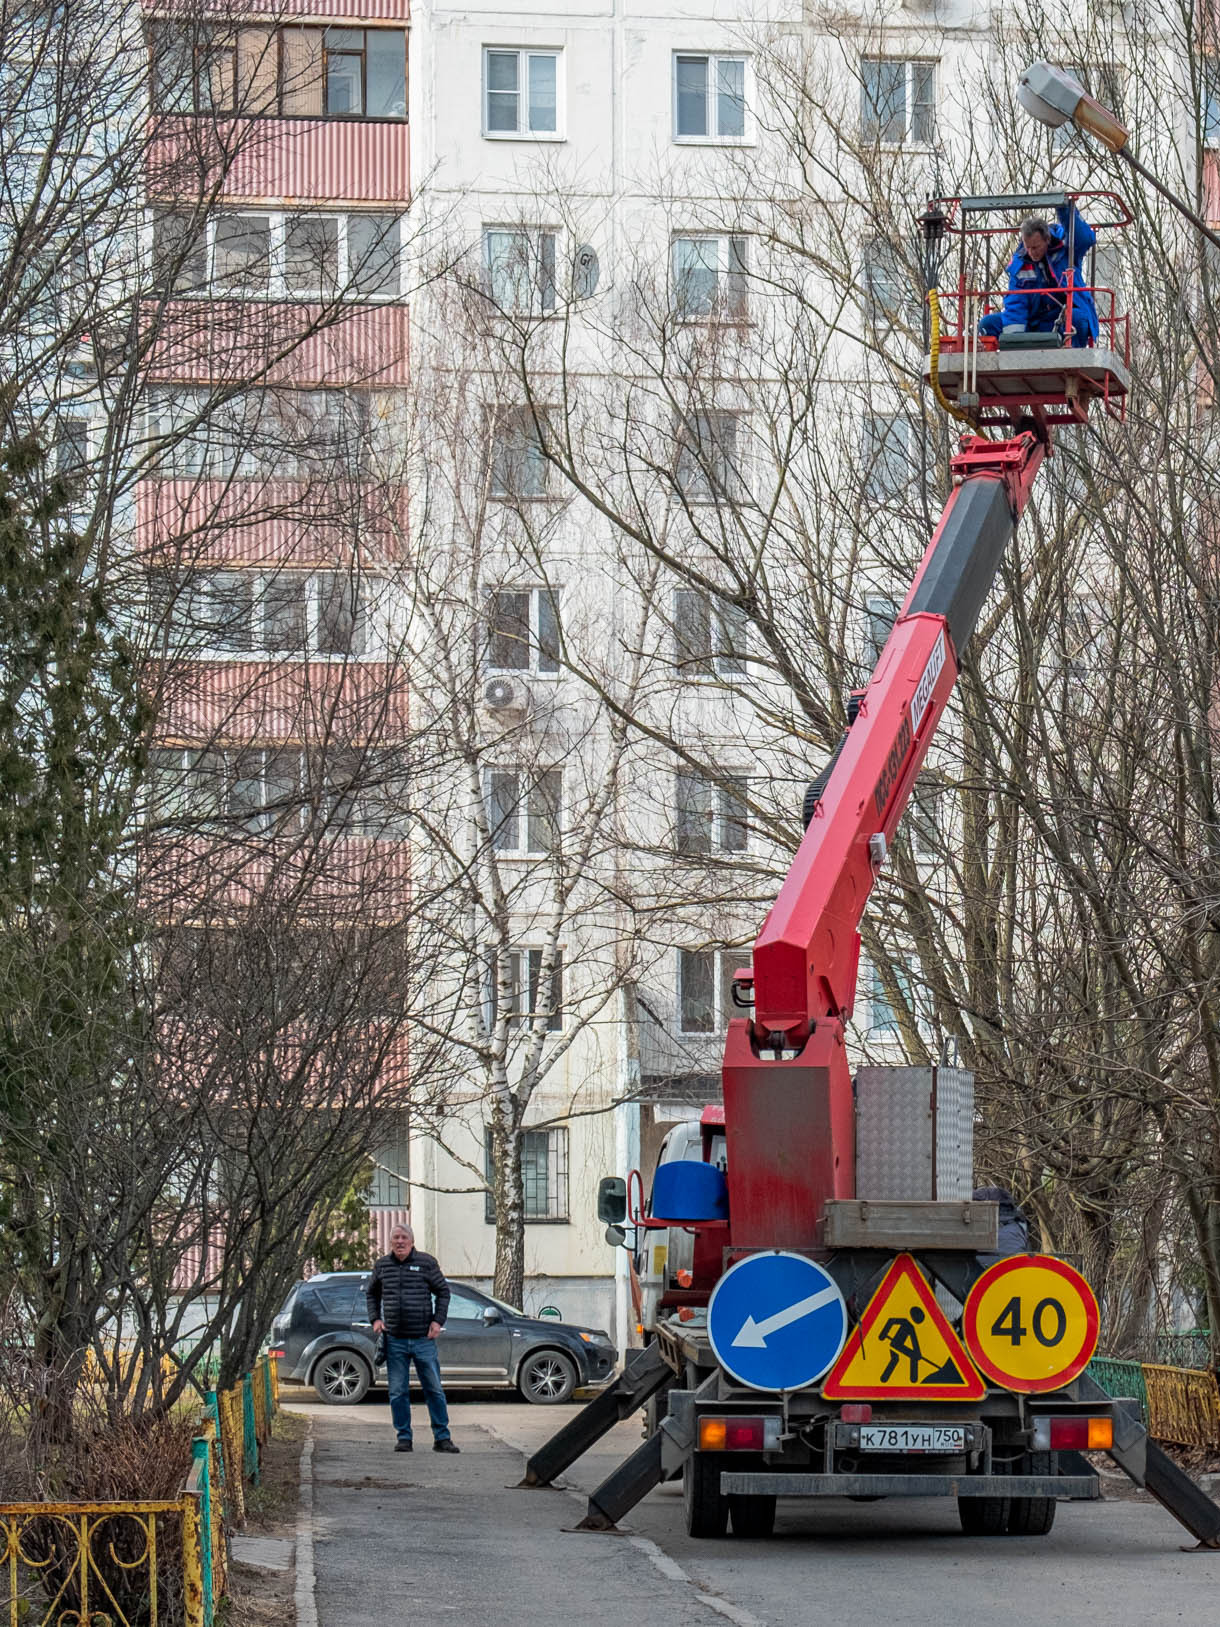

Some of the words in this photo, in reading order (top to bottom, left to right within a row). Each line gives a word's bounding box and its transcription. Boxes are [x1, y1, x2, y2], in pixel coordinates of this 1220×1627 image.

[913, 638, 944, 724] MEGALIFT
[991, 1296, 1067, 1347] 40
[935, 1430, 960, 1442] 750
